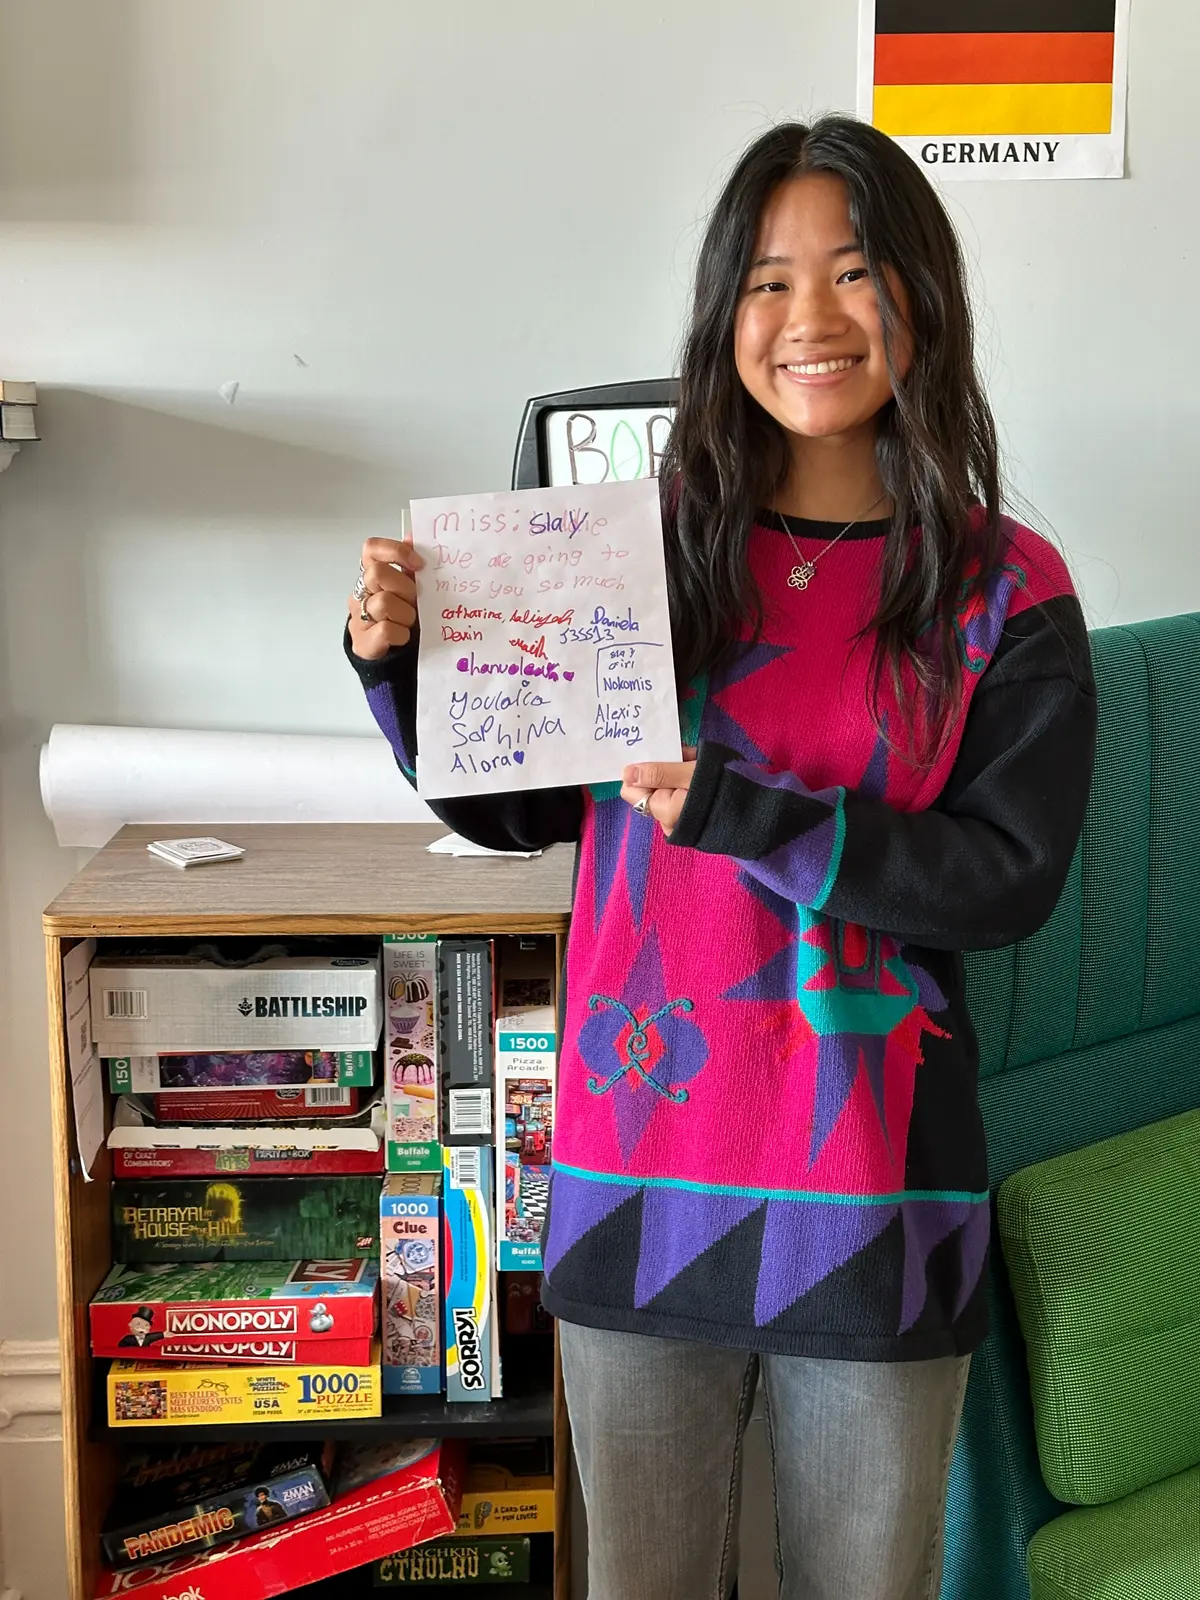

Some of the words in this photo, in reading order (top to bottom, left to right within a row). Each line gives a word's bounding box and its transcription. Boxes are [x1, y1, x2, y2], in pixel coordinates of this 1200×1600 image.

[921, 141, 1060, 164] GERMANY
[523, 546, 583, 573] going
[601, 544, 629, 560] to
[436, 576, 481, 593] miss
[490, 583, 524, 599] you
[537, 582, 564, 593] so
[574, 575, 625, 590] much
[590, 606, 640, 631] Daniela
[603, 676, 653, 691] Nokomis
[595, 704, 641, 724] Alexis
[450, 753, 512, 774] Alora
[255, 996, 367, 1018] BATTLESHIP
[509, 1037, 548, 1049] 1500
[345, 1052, 353, 1077] Buffal
[512, 1057, 542, 1065] Pizza
[116, 1060, 129, 1085] 150
[292, 1150, 310, 1158] BOX
[397, 1147, 430, 1156] Buffalo
[123, 1206, 209, 1225] BETRAYAL
[391, 1203, 428, 1215] 1000
[135, 1222, 190, 1239] HOUSE
[207, 1220, 247, 1237] HILL
[393, 1221, 427, 1234] Clue
[172, 1310, 293, 1332] MONOPOLY
[167, 1340, 291, 1356] MONOPOLY
[455, 1309, 482, 1388] SORRY!
[297, 1373, 359, 1404] 1000
[254, 1400, 280, 1408] USA
[316, 1393, 373, 1405] PUZZLE
[124, 1507, 235, 1560] PANDEMIC
[381, 1556, 479, 1581] CTHULHU
